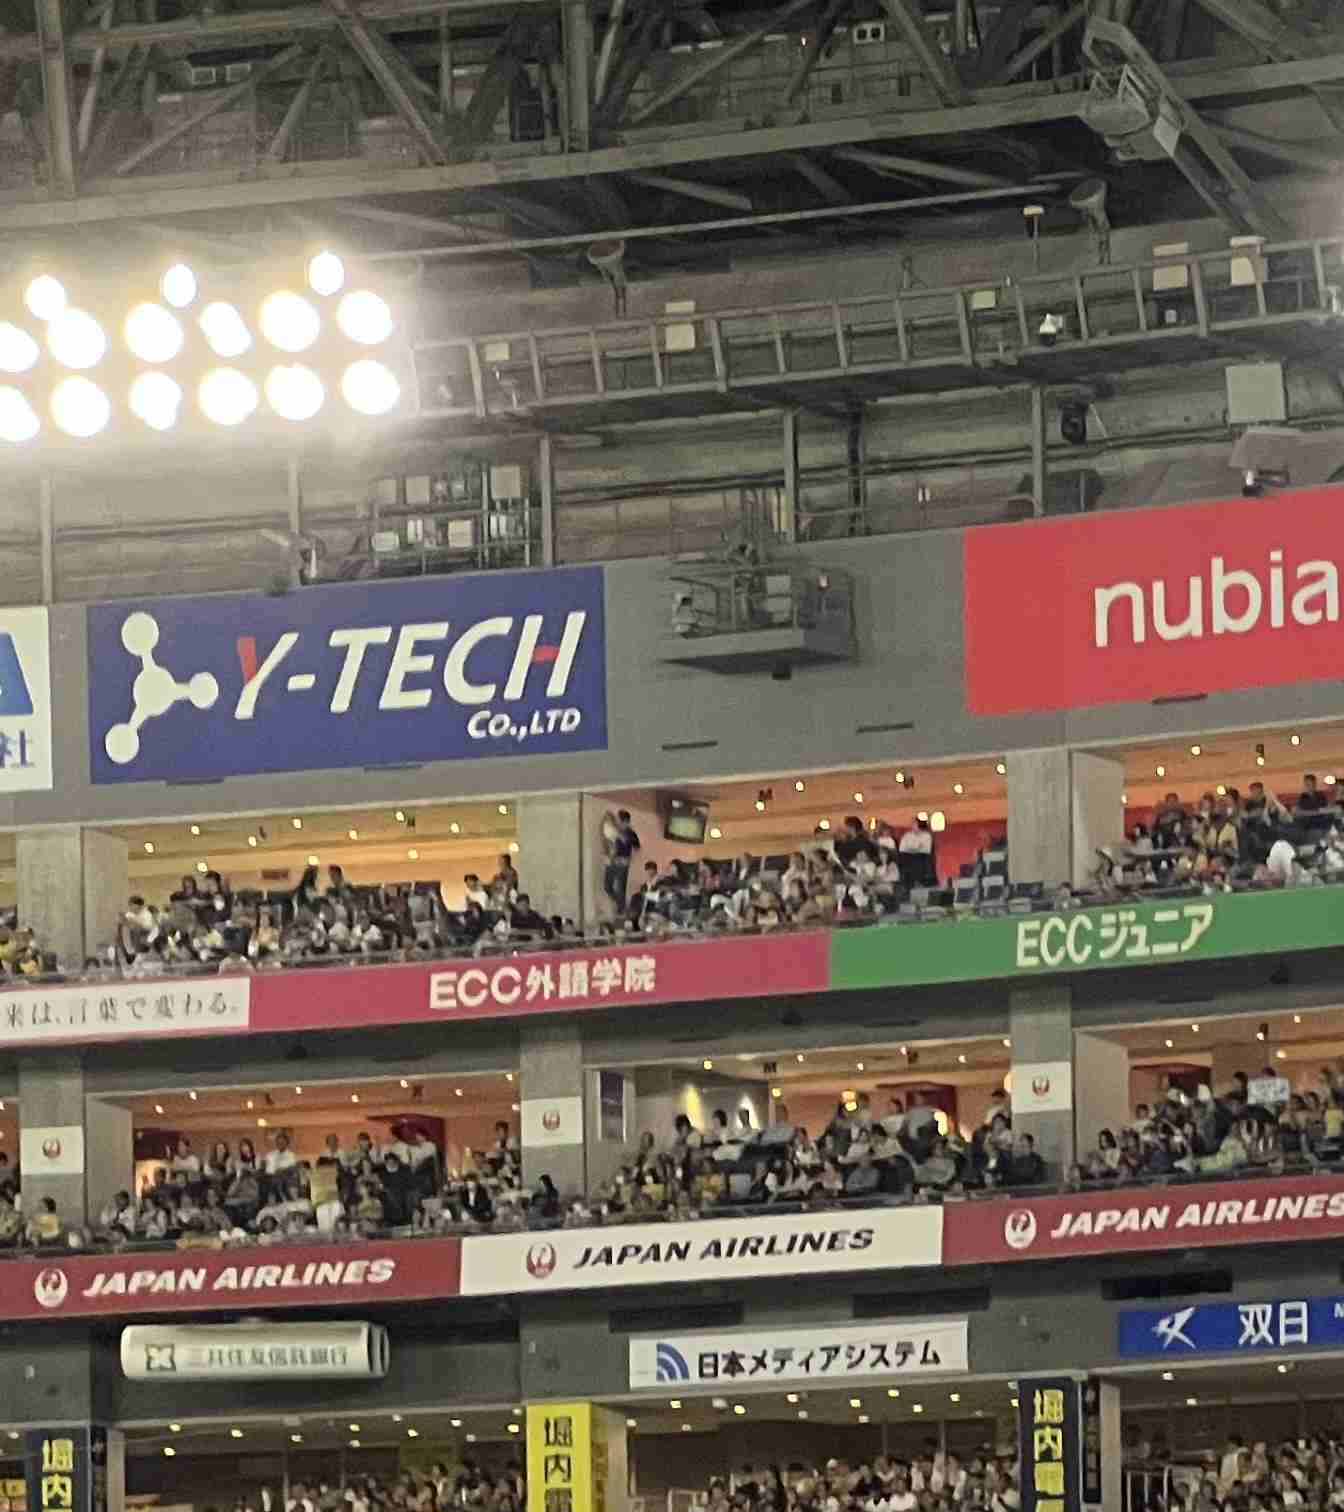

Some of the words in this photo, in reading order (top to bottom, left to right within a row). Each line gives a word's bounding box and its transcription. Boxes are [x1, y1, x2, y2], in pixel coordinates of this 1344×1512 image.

[1092, 548, 1340, 647] nubia
[234, 611, 586, 720] Y-TECH
[1016, 904, 1214, 968] ECCジュニア
[429, 956, 655, 1010] ECC外語学院
[1050, 1206, 1170, 1239] JAPAN
[573, 1237, 691, 1269] JAPAN
[699, 1228, 874, 1262] AIRLINES
[83, 1266, 205, 1298] JAPAN
[212, 1258, 395, 1291] AIRLINES
[1237, 1301, 1308, 1347] 双日
[698, 1340, 941, 1378] 日本メディアシステム
